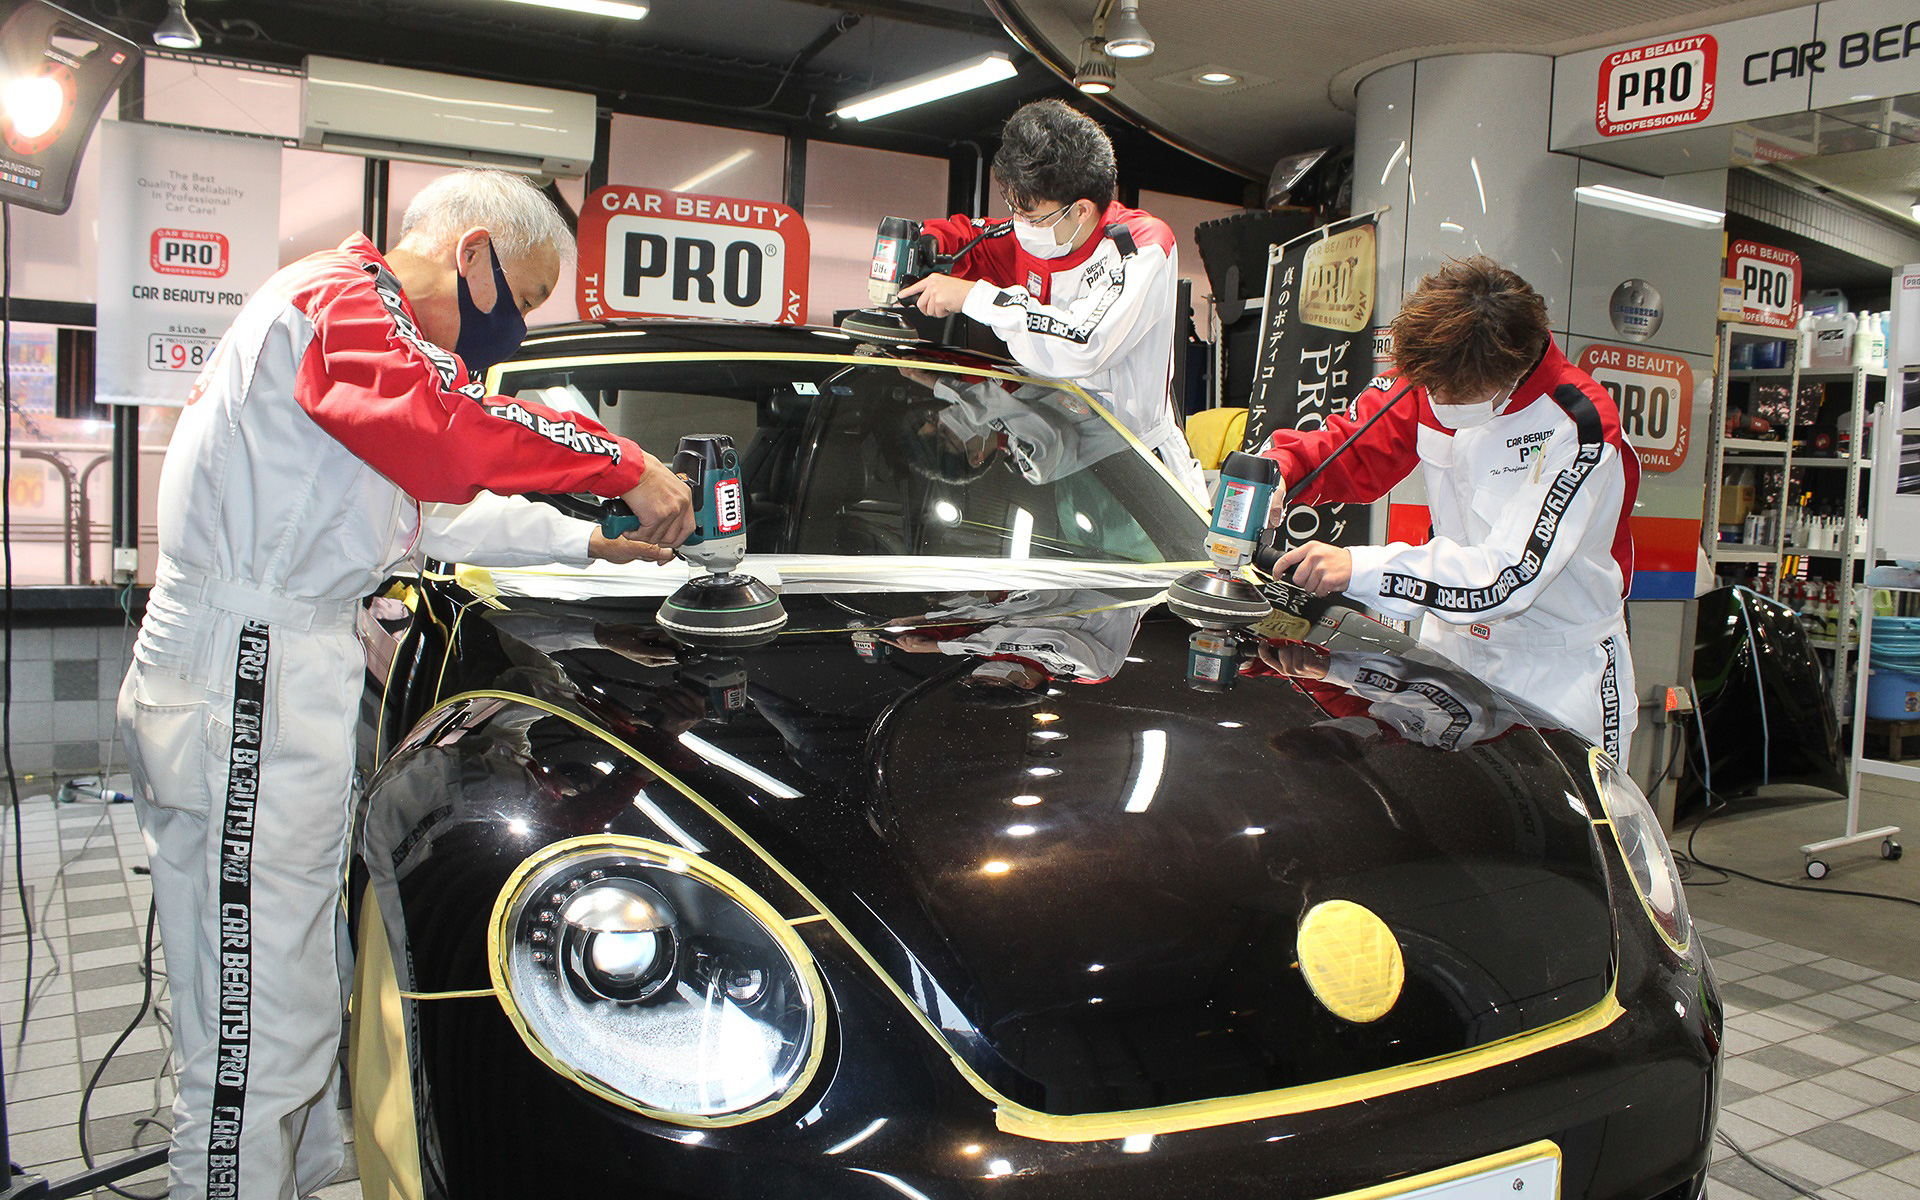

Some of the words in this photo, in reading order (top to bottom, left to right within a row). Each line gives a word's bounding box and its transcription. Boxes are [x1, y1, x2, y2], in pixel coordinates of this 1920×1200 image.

[1610, 51, 1642, 66] CAR
[1645, 37, 1706, 59] BEAUTY
[1743, 41, 1826, 86] CAR
[1617, 61, 1692, 111] PRO
[1598, 101, 1608, 128] THE
[1609, 112, 1697, 133] PROFESSIONAL
[1700, 83, 1713, 111] WAY
[137, 177, 177, 191] Quality
[181, 183, 188, 192] &
[193, 183, 244, 199] Reliability
[169, 169, 188, 180] The
[192, 172, 215, 184] Best
[152, 191, 162, 200] In
[166, 191, 230, 206] Professional
[165, 202, 184, 213] Car
[601, 192, 662, 213] CAR
[675, 198, 789, 228] BEAUTY
[165, 242, 212, 265] PRO
[1735, 243, 1757, 256] CAR
[1760, 247, 1796, 266] BEAUTY
[132, 285, 159, 300] CAR
[163, 288, 215, 304] BEAUTY
[218, 292, 243, 306] PRO
[584, 273, 605, 319] THE
[1743, 264, 1787, 309] PRO
[1354, 291, 1367, 321] WAY
[169, 324, 206, 335] since
[1589, 350, 1621, 366] CAR
[1626, 353, 1684, 376] BEAUTY
[490, 403, 535, 431] CAR
[1506, 436, 1522, 448] CAR
[1523, 429, 1555, 444] BEAUTY
[1673, 425, 1687, 457] WAY
[724, 488, 737, 522] PRO
[1515, 549, 1541, 582] CAR
[1394, 576, 1427, 601] CAR
[1473, 625, 1487, 636] PRO
[238, 634, 268, 683] PRO
[234, 698, 261, 746] CAR
[225, 747, 259, 837] BEAUTY
[222, 839, 251, 886] PRO
[221, 902, 250, 949] CAR
[221, 952, 250, 1041] BEAUTY
[218, 1044, 248, 1089] PRO
[212, 1106, 242, 1151] CAR
